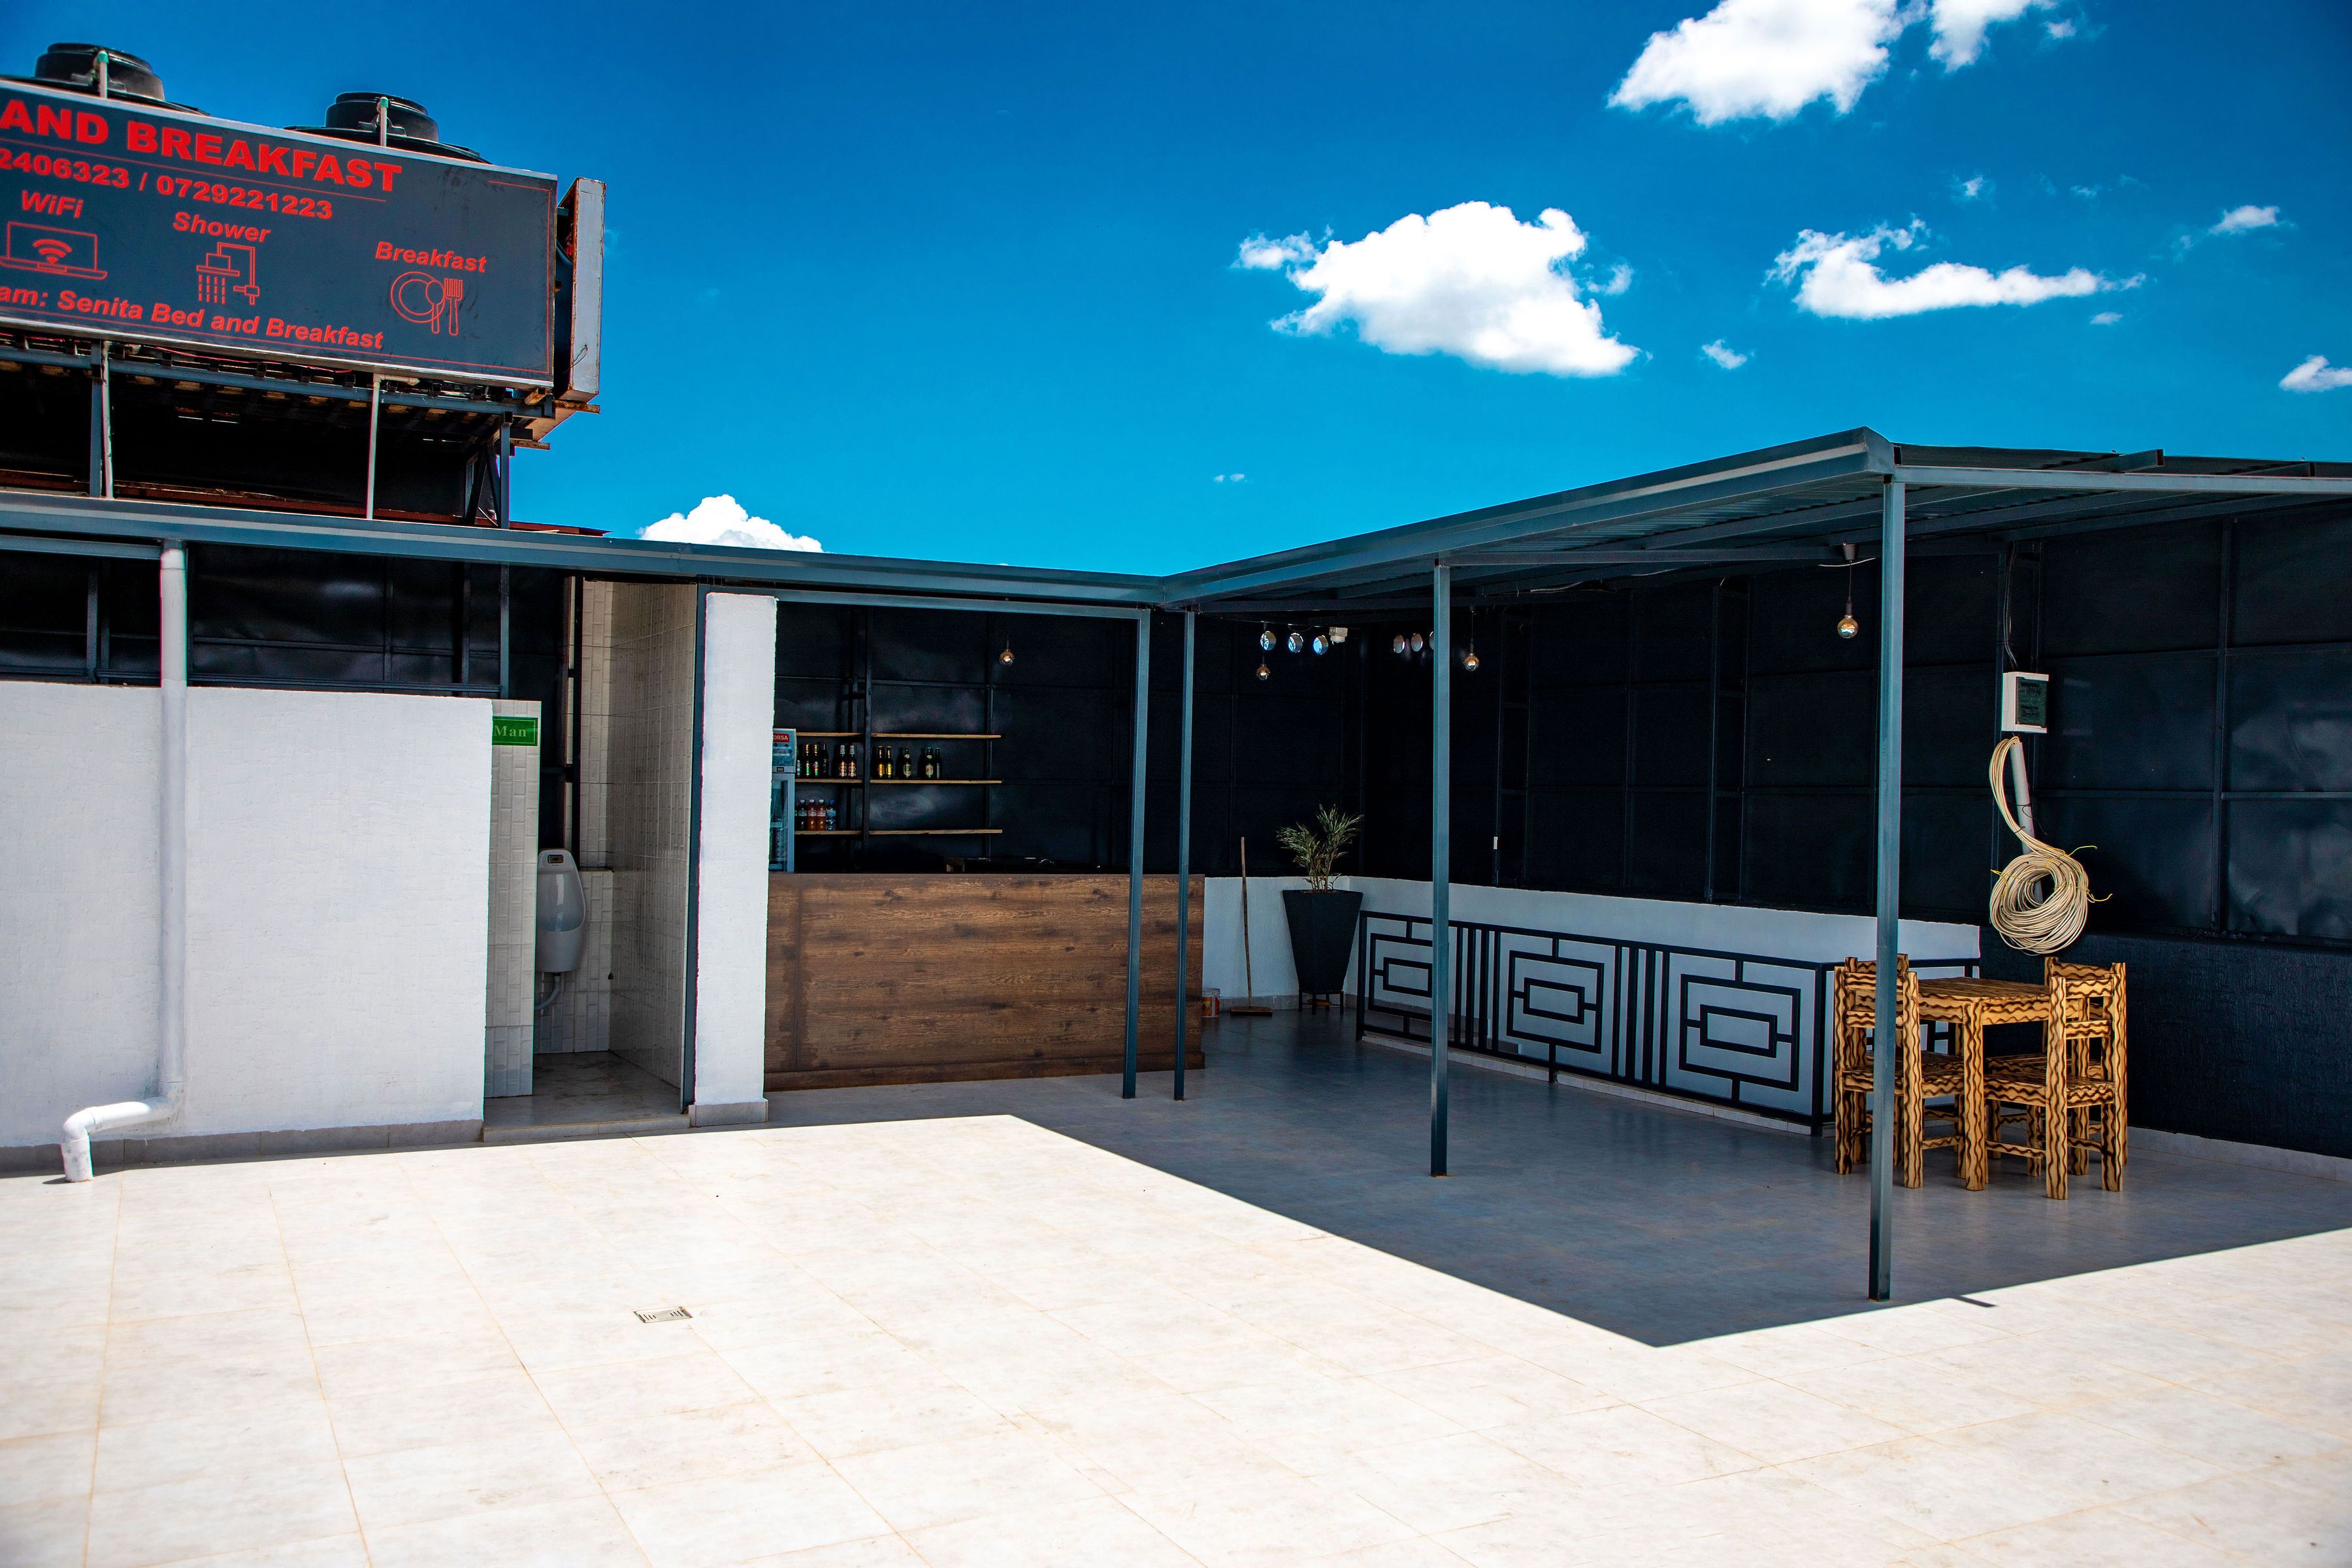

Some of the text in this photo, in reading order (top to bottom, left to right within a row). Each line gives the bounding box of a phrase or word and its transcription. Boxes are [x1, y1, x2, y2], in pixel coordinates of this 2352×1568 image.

[0, 99, 402, 192] AND BREAKFAST
[22, 190, 84, 218] WiFi
[157, 175, 333, 220] 0729221223
[172, 212, 271, 243] Shower
[376, 241, 487, 273] Breakfast
[57, 290, 143, 319] Senita
[151, 302, 205, 327] Bed
[210, 316, 260, 335] and
[266, 318, 384, 350] Breakfast
[493, 725, 527, 737] Man
